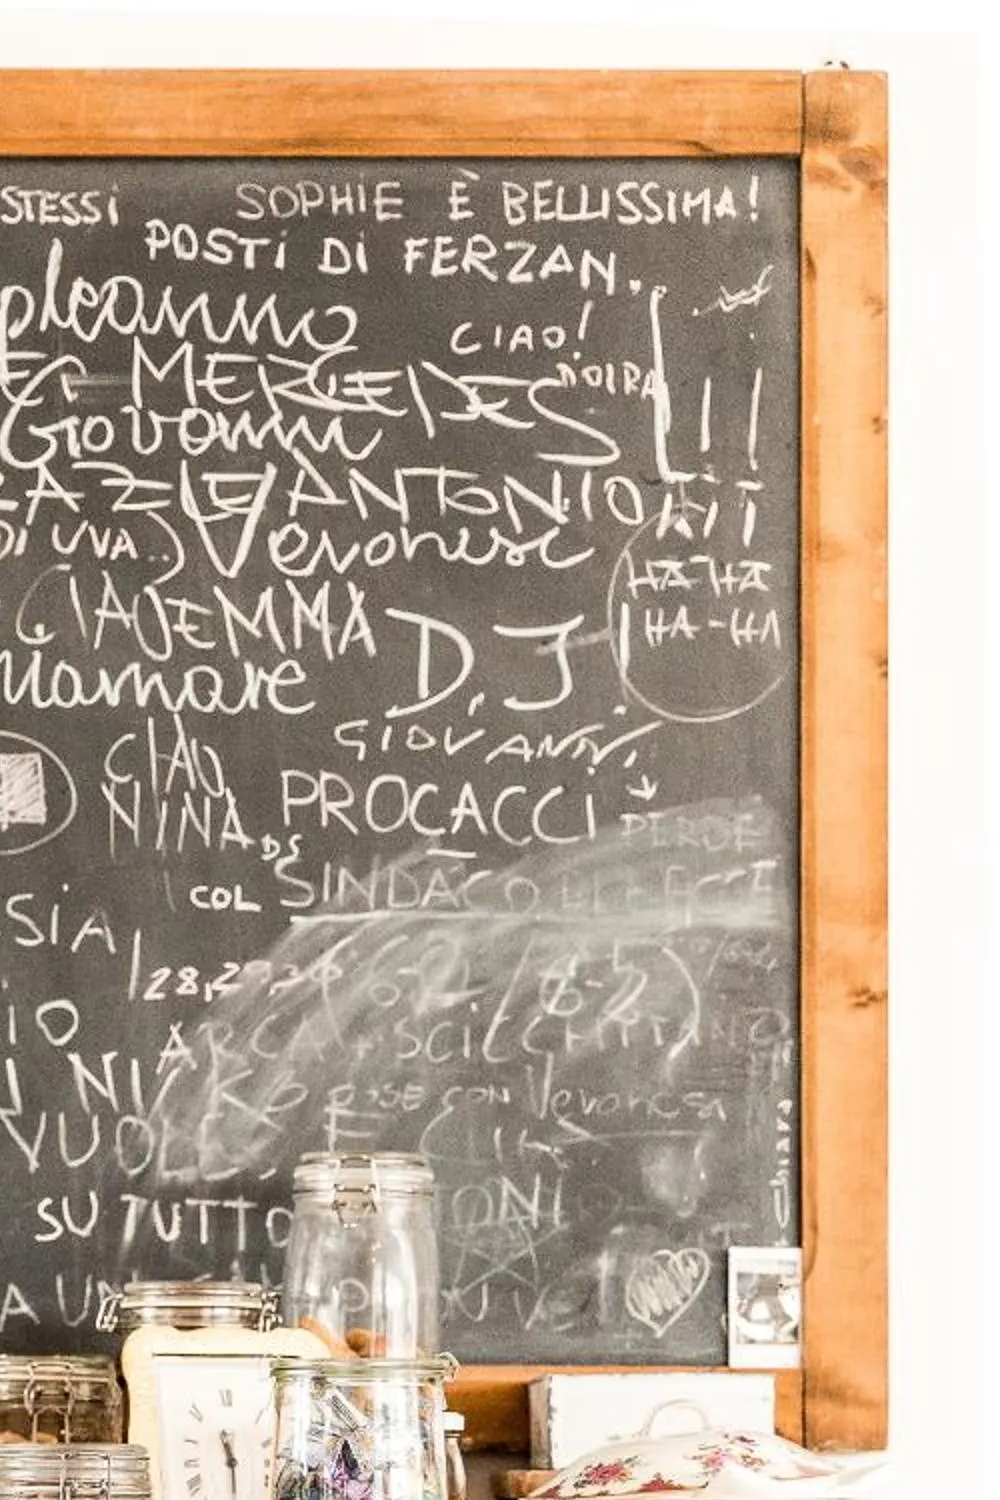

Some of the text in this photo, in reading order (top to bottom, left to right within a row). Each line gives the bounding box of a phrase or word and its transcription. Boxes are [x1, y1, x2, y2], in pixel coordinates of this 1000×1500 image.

[0, 184, 120, 225] STESSI
[235, 173, 404, 221] SOPHIE
[144, 217, 288, 266] POSTI
[318, 231, 369, 275] DI
[101, 785, 256, 862] NINA
[280, 769, 597, 849] PROCACCI
[189, 883, 263, 913] COL
[33, 1190, 99, 1247] SU
[119, 1192, 296, 1251] TUTTO
